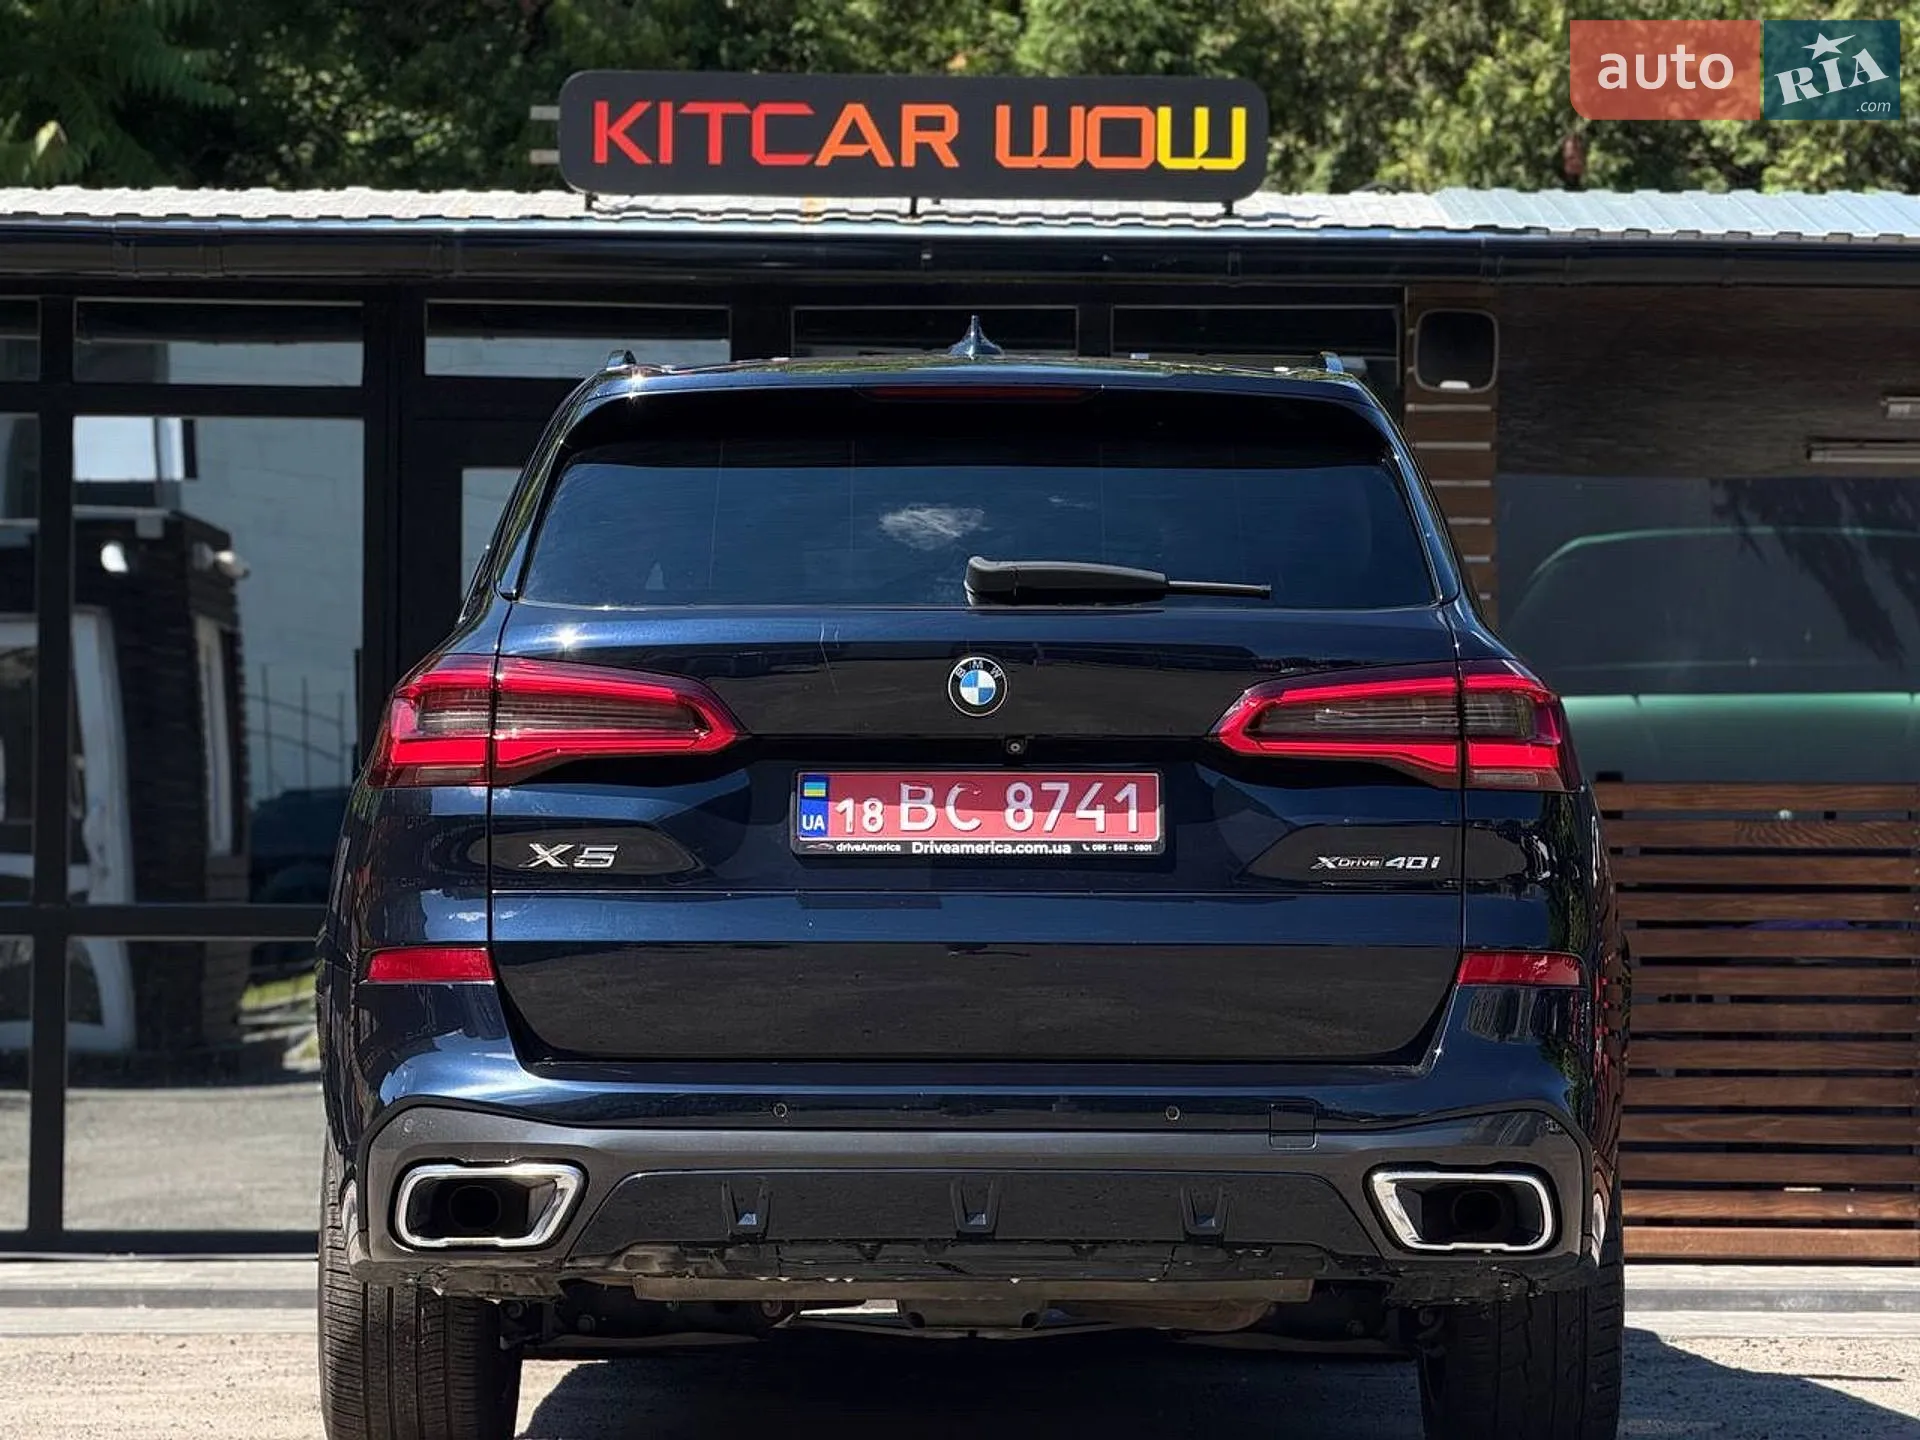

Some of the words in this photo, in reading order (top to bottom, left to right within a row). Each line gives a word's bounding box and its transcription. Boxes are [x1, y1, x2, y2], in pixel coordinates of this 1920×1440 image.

[593, 101, 960, 168] KITCAR
[995, 105, 1247, 170] WOW
[835, 797, 885, 834] 18
[900, 781, 982, 833] BC
[1004, 781, 1139, 833] 8741
[802, 814, 826, 831] UA
[518, 843, 619, 868] X5
[911, 840, 1072, 855] Driveamerica.com.ua
